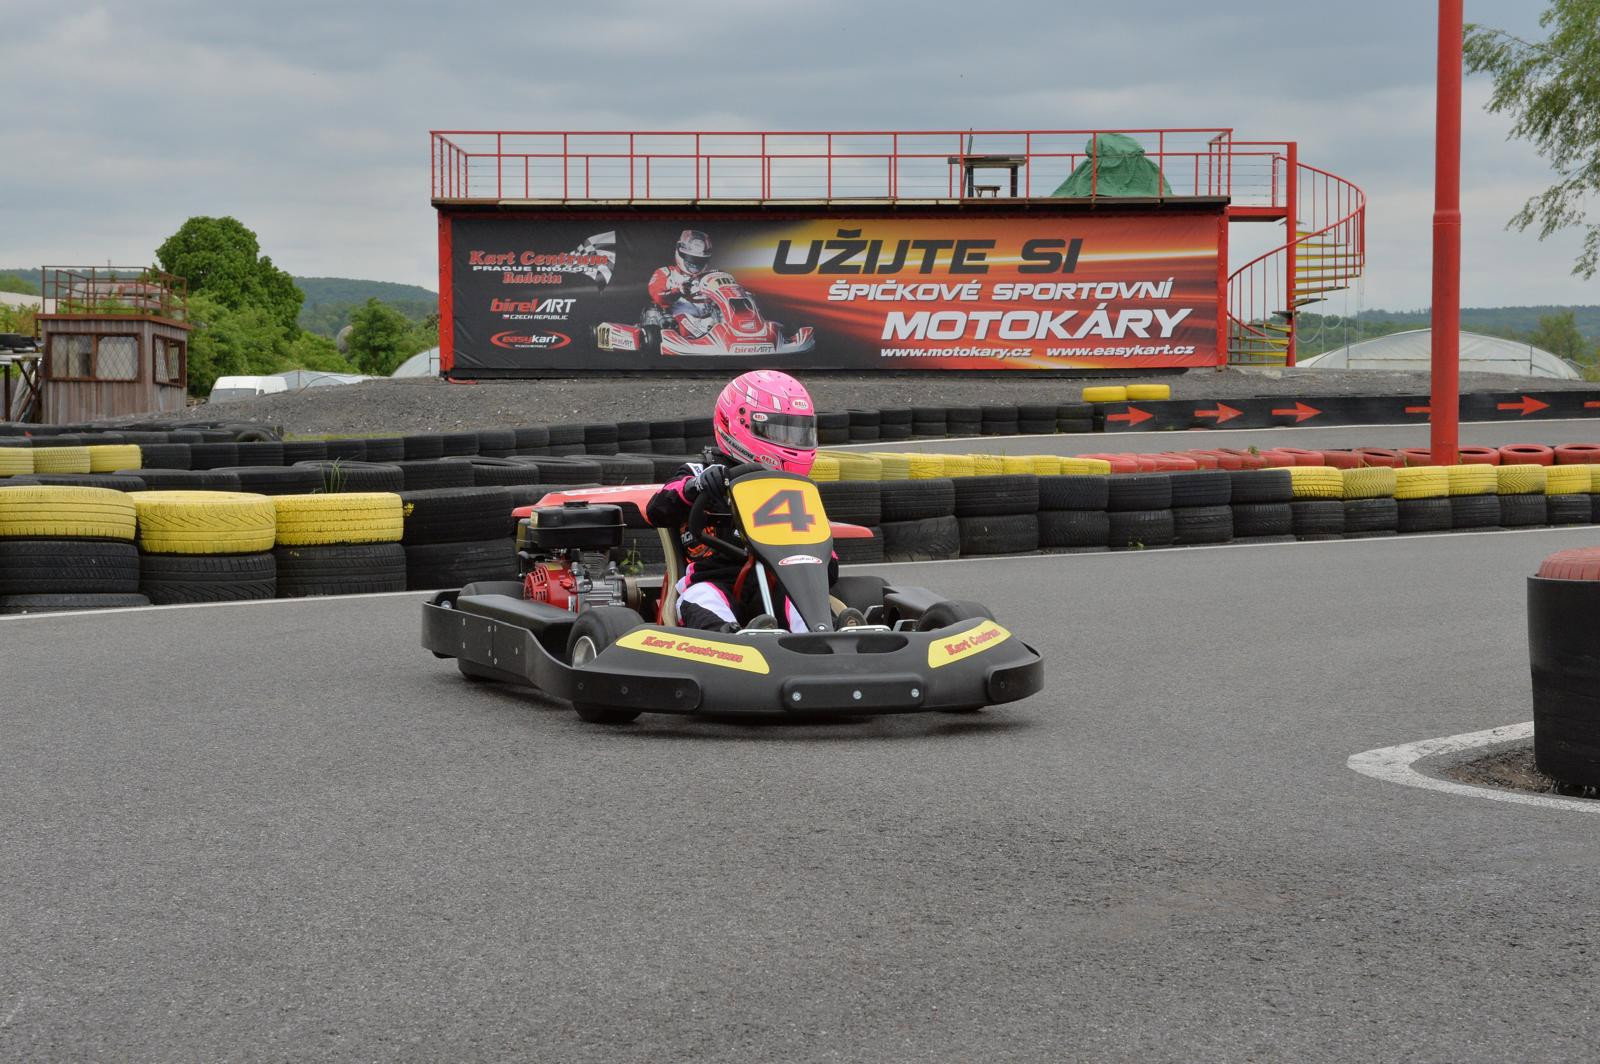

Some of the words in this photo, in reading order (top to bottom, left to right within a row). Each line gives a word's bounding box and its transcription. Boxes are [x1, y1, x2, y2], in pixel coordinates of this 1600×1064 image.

[469, 250, 516, 265] Kart
[520, 250, 608, 266] Centrum
[772, 228, 996, 275] UŽIJTE
[1017, 238, 1084, 275] SI
[827, 279, 982, 301] ŠPIČKOVÉ
[991, 277, 1175, 301] SPORTOVNÍ
[490, 298, 576, 313] birelART
[881, 303, 1193, 340] MOTOKÁRY
[502, 334, 557, 344] easykart
[880, 346, 1032, 359] www.motokary.cz
[1046, 344, 1195, 357] www.easykart.cz
[752, 489, 816, 532] 4
[641, 636, 676, 650] Kart
[677, 641, 744, 663] Centrum
[944, 640, 971, 655] Kart
